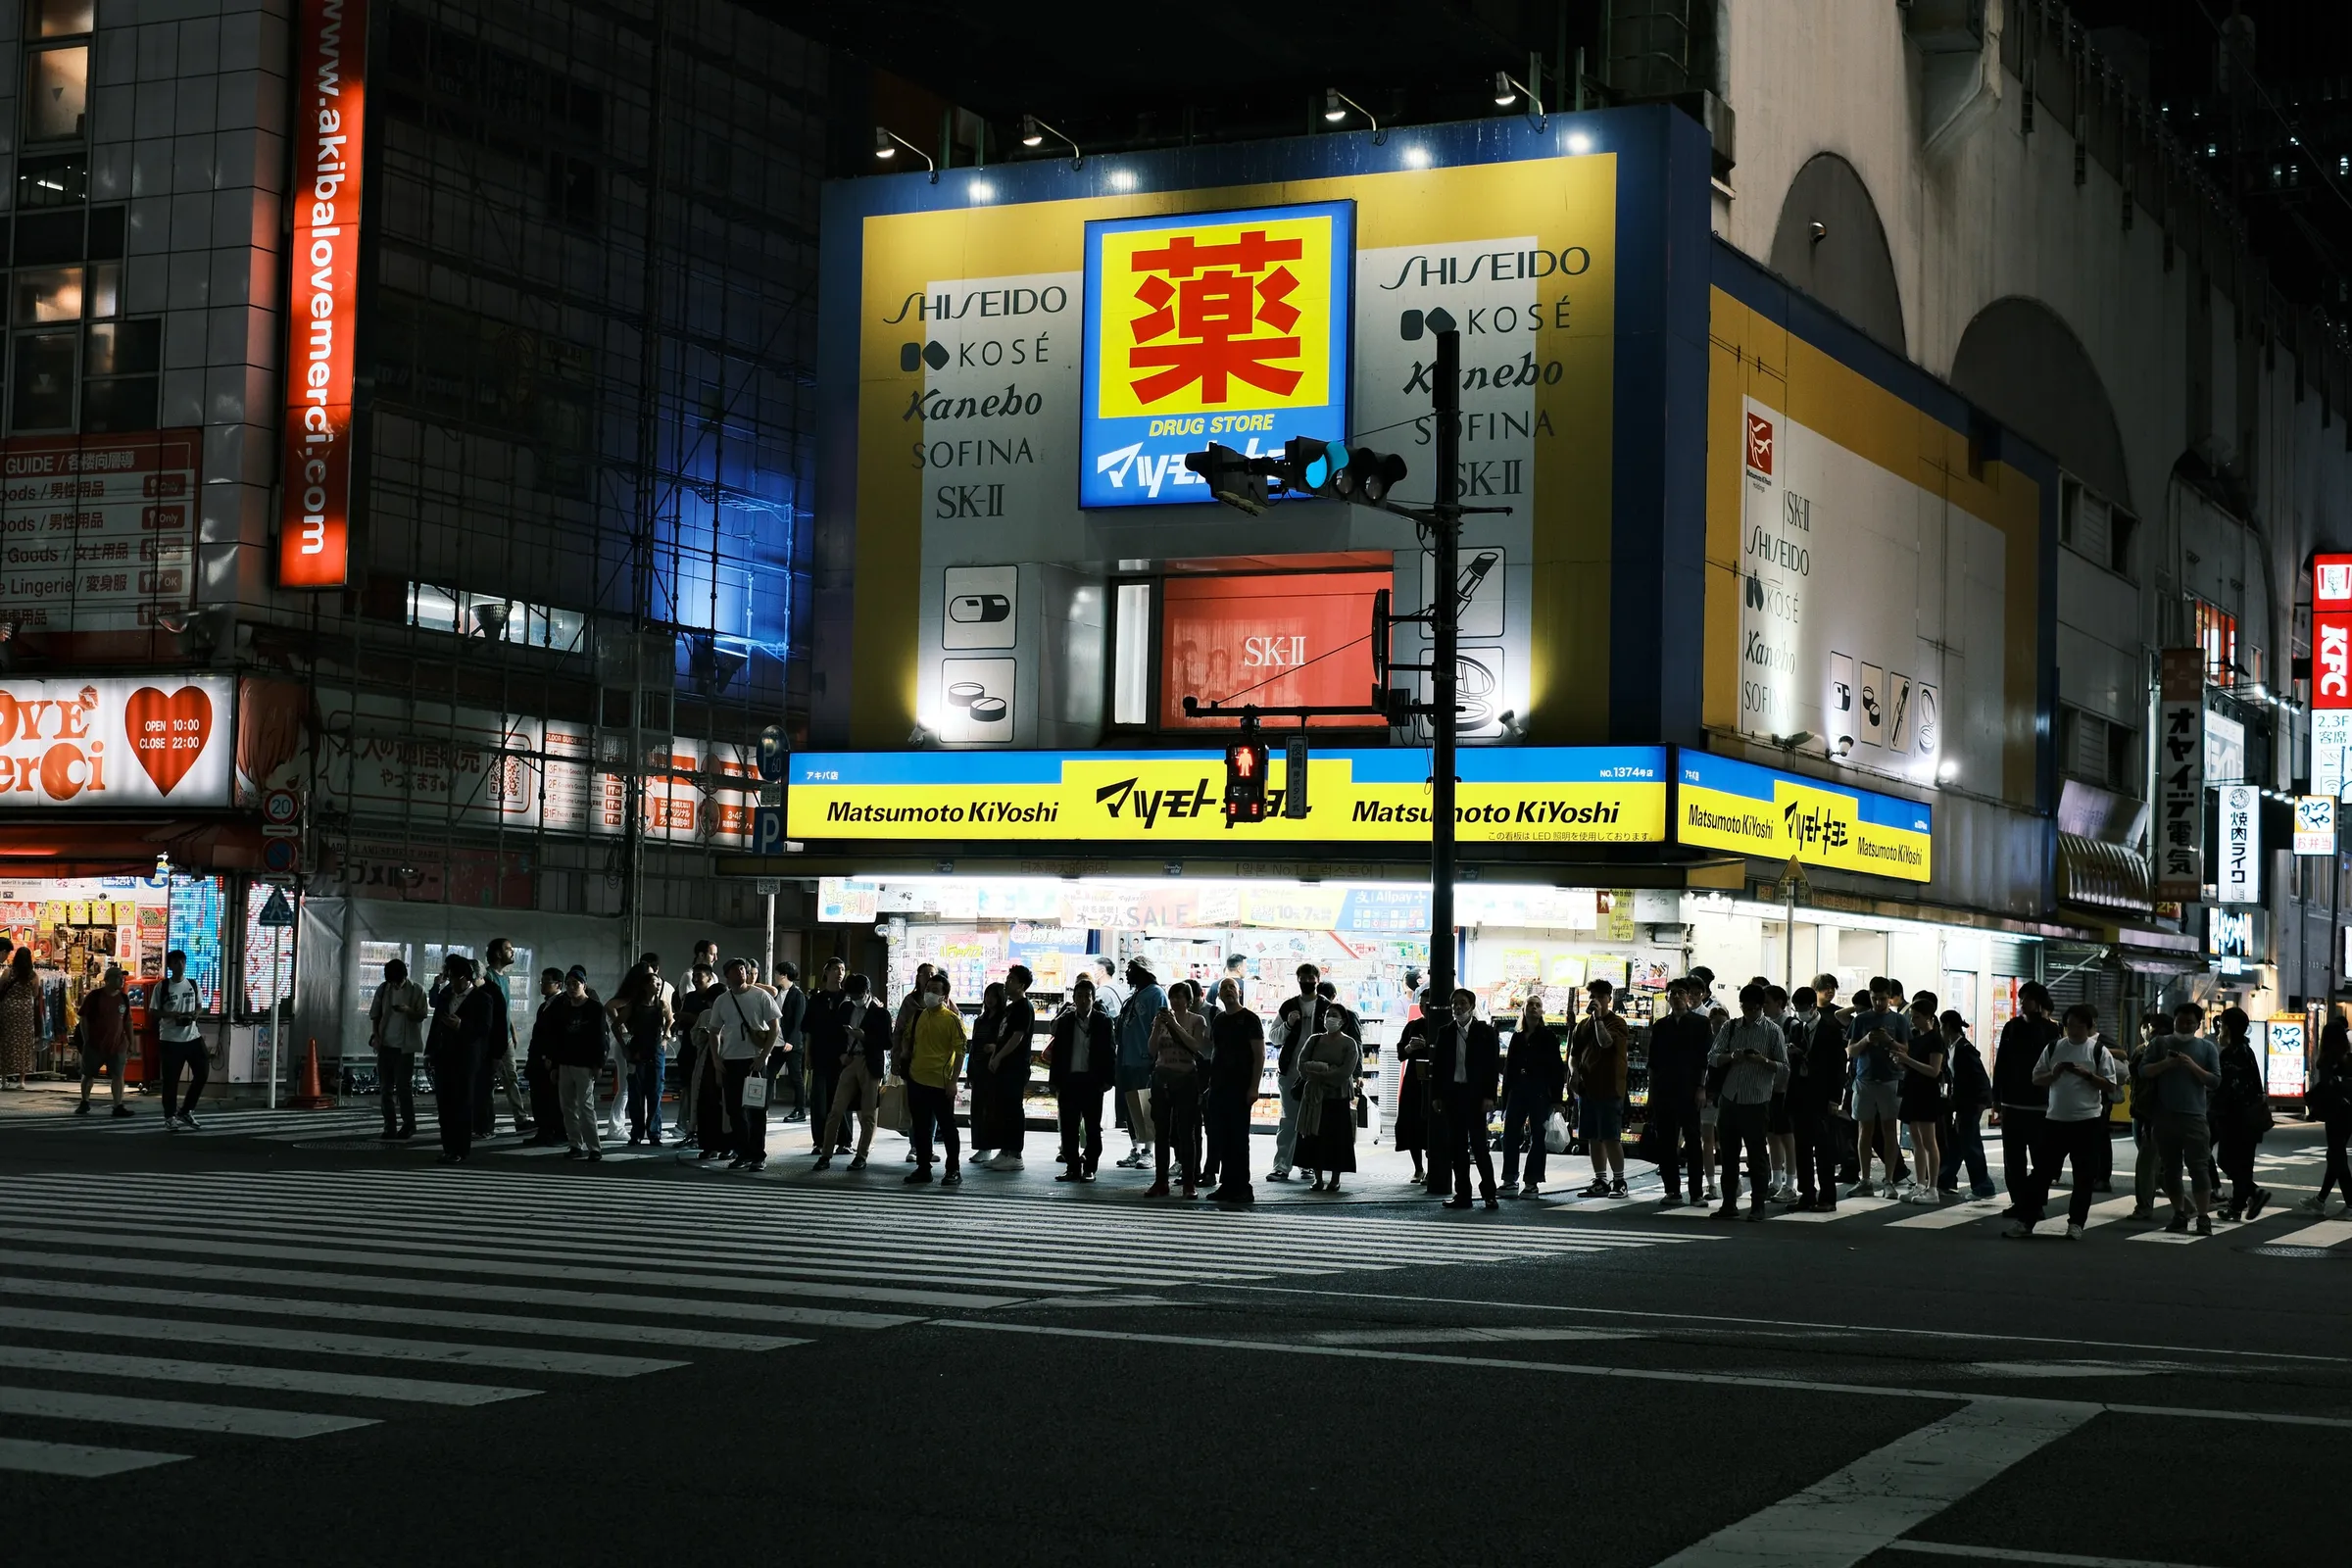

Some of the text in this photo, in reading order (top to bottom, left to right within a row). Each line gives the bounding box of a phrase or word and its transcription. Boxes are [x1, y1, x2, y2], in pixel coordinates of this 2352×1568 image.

[1380, 246, 1591, 290] SHISEIDO
[883, 285, 1067, 324] SHISEIDO
[1468, 295, 1571, 335] KOSÉ
[1129, 230, 1304, 406] 薬
[959, 331, 1050, 368] KOSÉ
[1402, 351, 1564, 395] Knebo
[902, 382, 1043, 422] Kanebo
[1149, 414, 1275, 437] DRUG STORE
[1414, 409, 1555, 446] SFINA
[911, 437, 1034, 469] SOFINA
[5, 456, 54, 474] GUIDE
[50, 480, 105, 500] 男性用品
[160, 481, 179, 493] Only
[49, 512, 104, 530] 男性用品
[159, 514, 178, 523] Only
[8, 546, 59, 564] Goods
[74, 542, 128, 561] 女士用品
[1745, 525, 1810, 576] SHISEIDO
[11, 577, 74, 598] Lingerie
[86, 574, 127, 592] 変身服
[164, 578, 177, 587] OK
[1766, 592, 1799, 623] KOSÉ
[1744, 630, 1795, 675] Kanebo
[2320, 623, 2348, 698] KFC
[145, 719, 200, 731] OPEN 10:00
[139, 737, 200, 750] CLOSE 22:00
[563, 735, 578, 744] GUIDE
[2319, 730, 2347, 744] 客席
[762, 742, 776, 773] P
[771, 758, 781, 772] 60
[549, 764, 558, 774] 3F
[806, 771, 839, 781] アキバ店
[1599, 766, 1654, 778] NO.1374号店
[549, 779, 557, 789] 2F
[2166, 708, 2195, 876] オヤイデ電気
[272, 799, 291, 814] 20
[549, 794, 557, 804] 1F
[544, 808, 557, 817] B1F
[826, 801, 1059, 823] Matsumoto KiYoshi
[1514, 800, 1621, 824] KiYoshi
[1689, 804, 1775, 841] Matsumoto KiYoshi
[762, 812, 780, 854] P
[1488, 831, 1656, 842] この看板は LED 照明を使用しております。
[1784, 800, 1848, 856] マツモトキヨシ
[364, 845, 418, 858] AMUSEMET
[1857, 836, 1923, 866] Matsumoto KiYoshi
[2230, 811, 2248, 884] 焼肉ライク
[2295, 836, 2332, 850] お弁当
[1272, 863, 1299, 876] No.1
[1076, 912, 1124, 927] オータム
[1126, 904, 1190, 927] SALE
[2269, 1070, 2303, 1081] とんかつ
